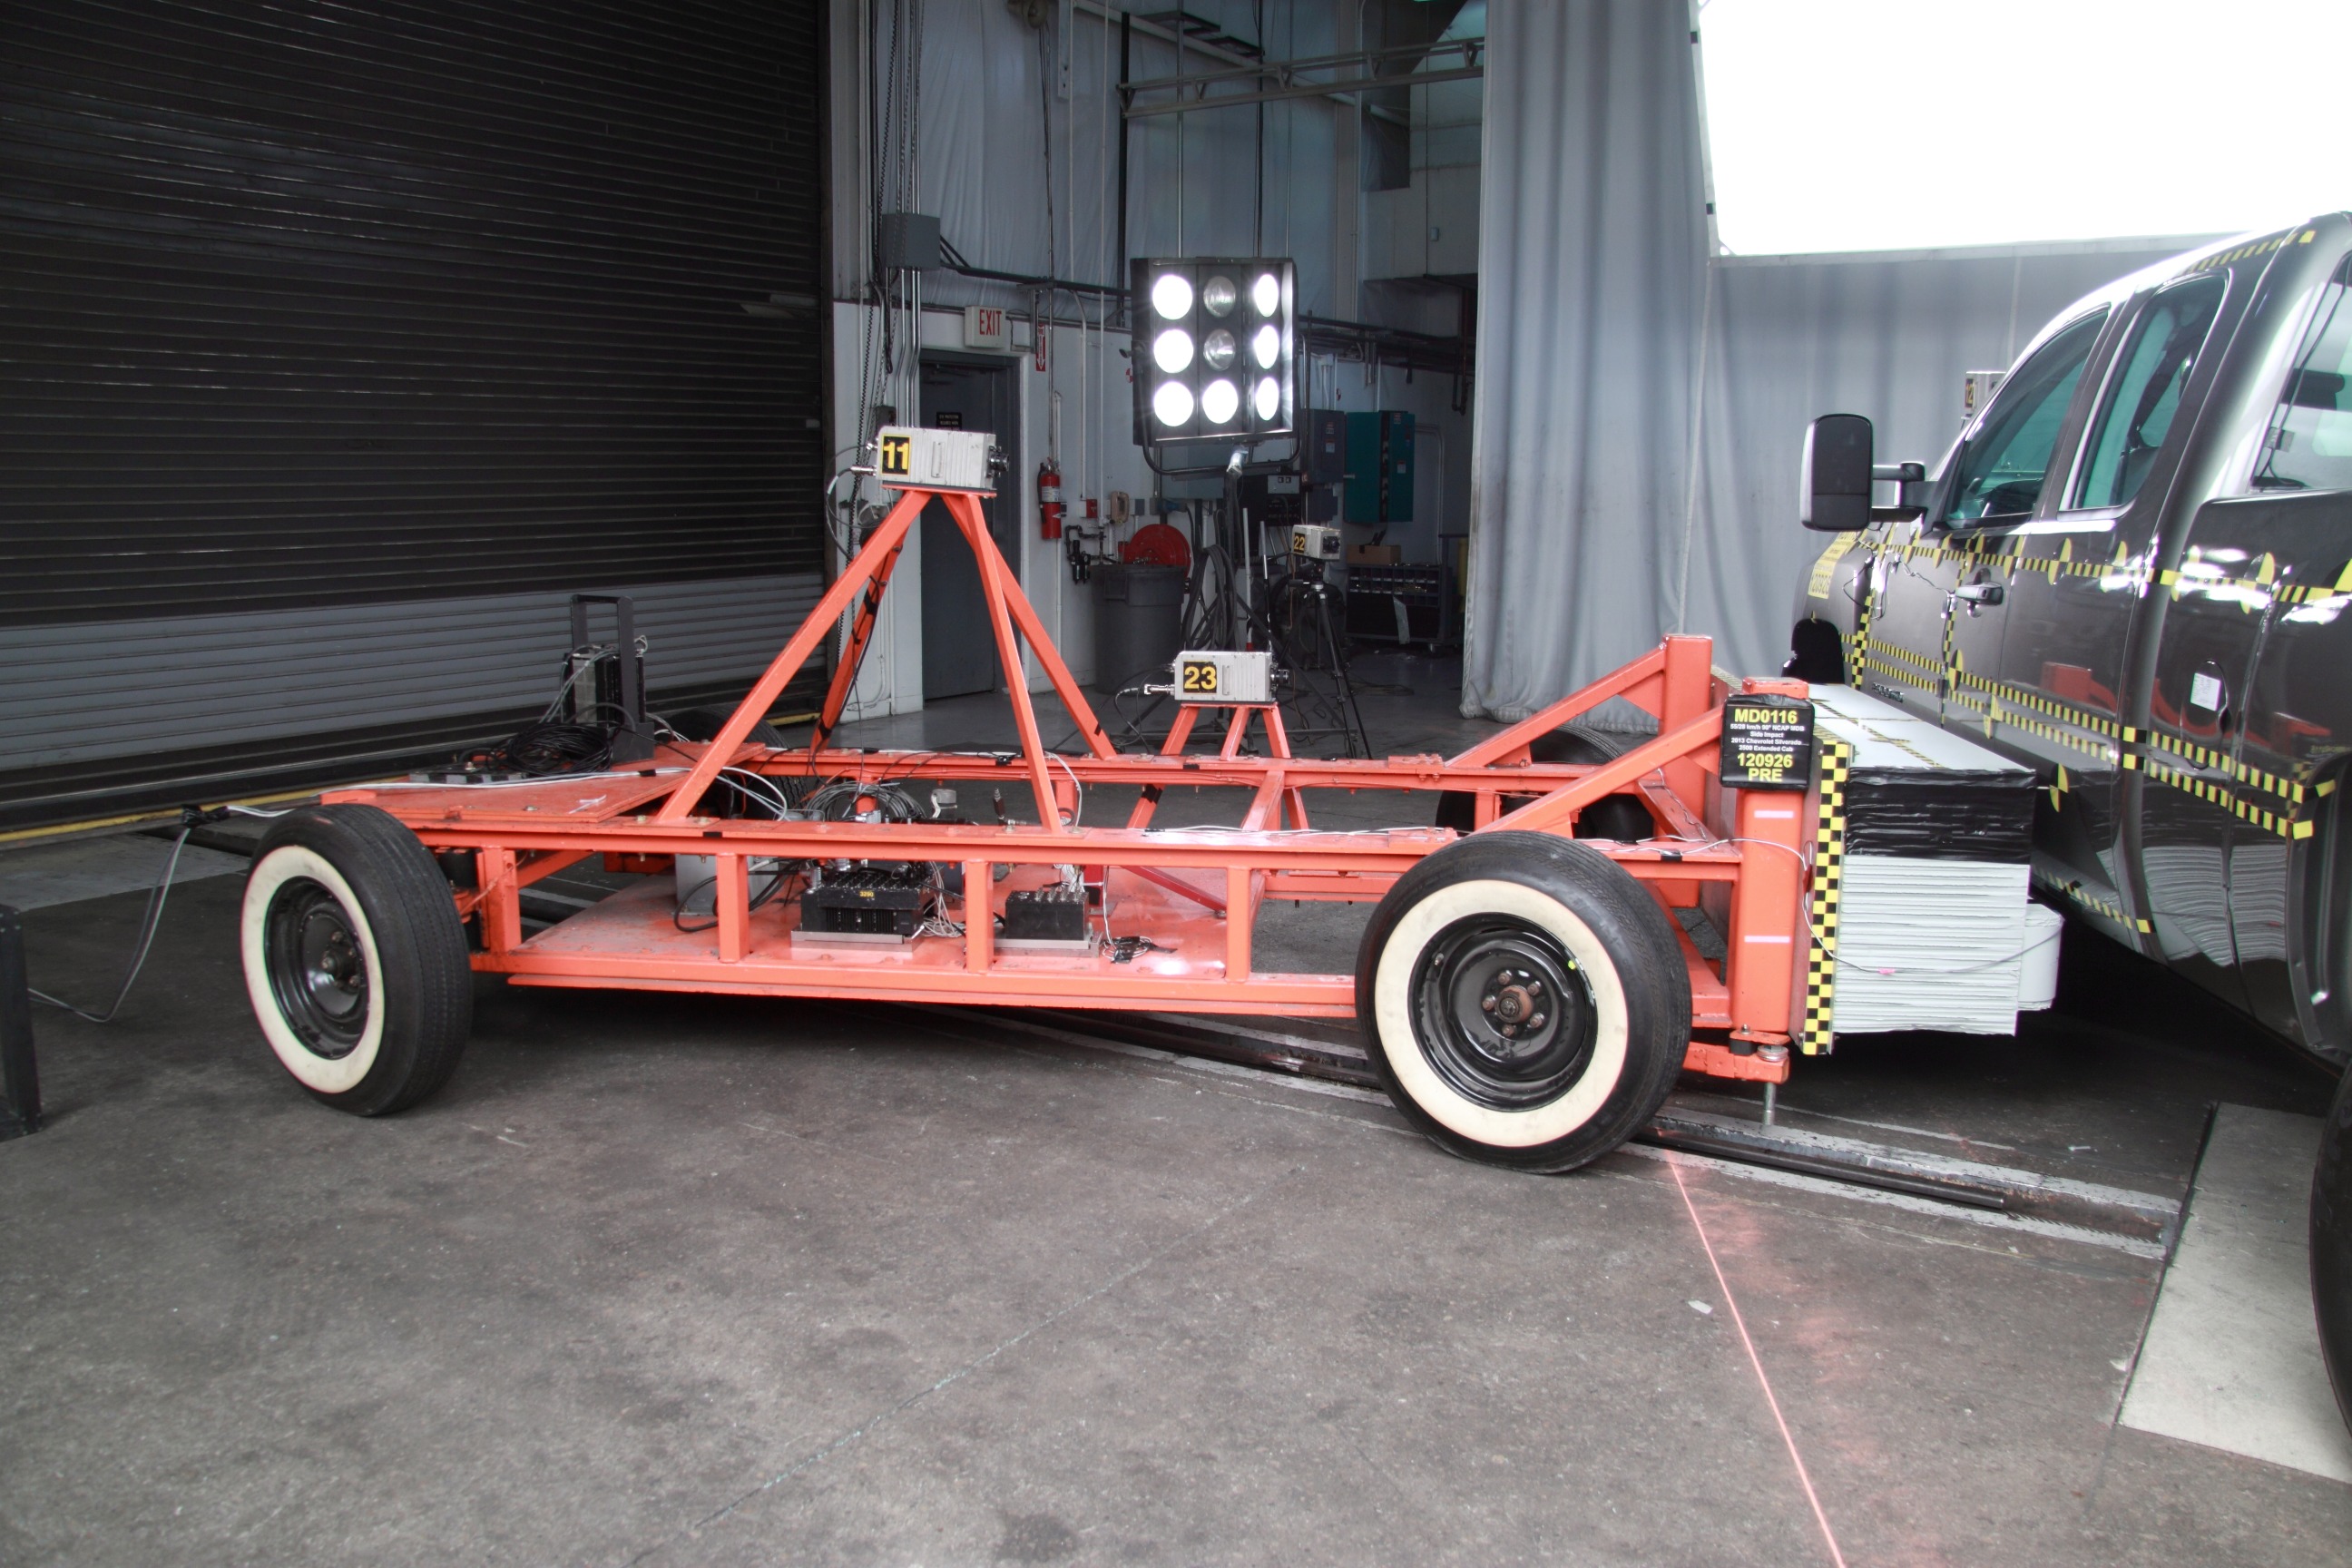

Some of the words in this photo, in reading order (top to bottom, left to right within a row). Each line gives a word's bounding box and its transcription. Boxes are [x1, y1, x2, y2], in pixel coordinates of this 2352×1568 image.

[979, 309, 1002, 336] EXIT
[883, 441, 909, 470] 11
[1294, 535, 1305, 551] 22
[1184, 666, 1217, 690] 23
[1734, 708, 1798, 724] MD0116
[1738, 752, 1793, 768] 120926
[1749, 768, 1783, 782] PRE
